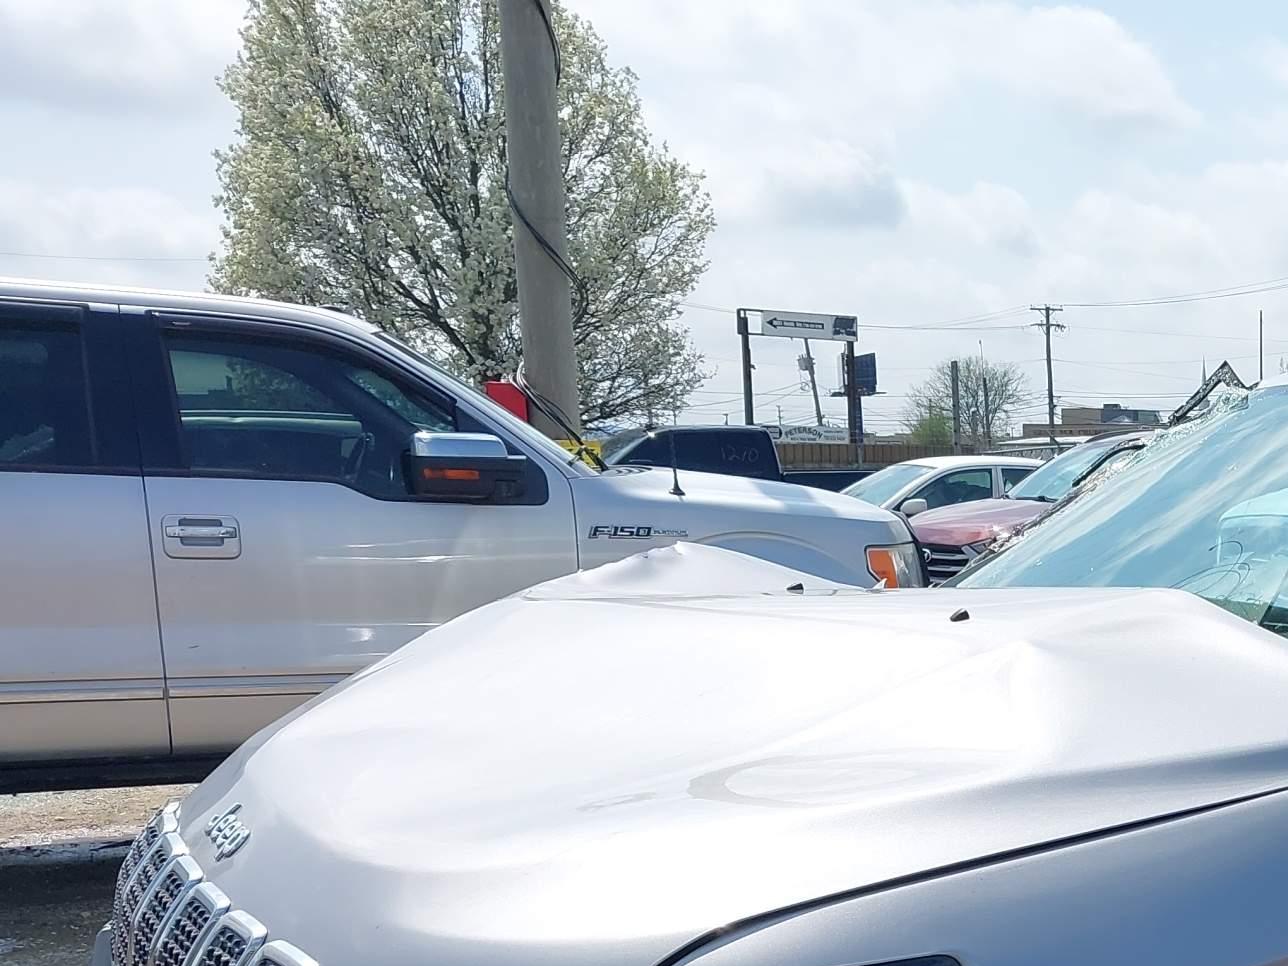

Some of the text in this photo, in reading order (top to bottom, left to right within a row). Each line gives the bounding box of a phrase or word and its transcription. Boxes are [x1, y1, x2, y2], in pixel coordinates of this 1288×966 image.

[784, 426, 824, 440] PETERSON
[588, 525, 653, 540] F-150
[204, 802, 252, 862] Jeep
